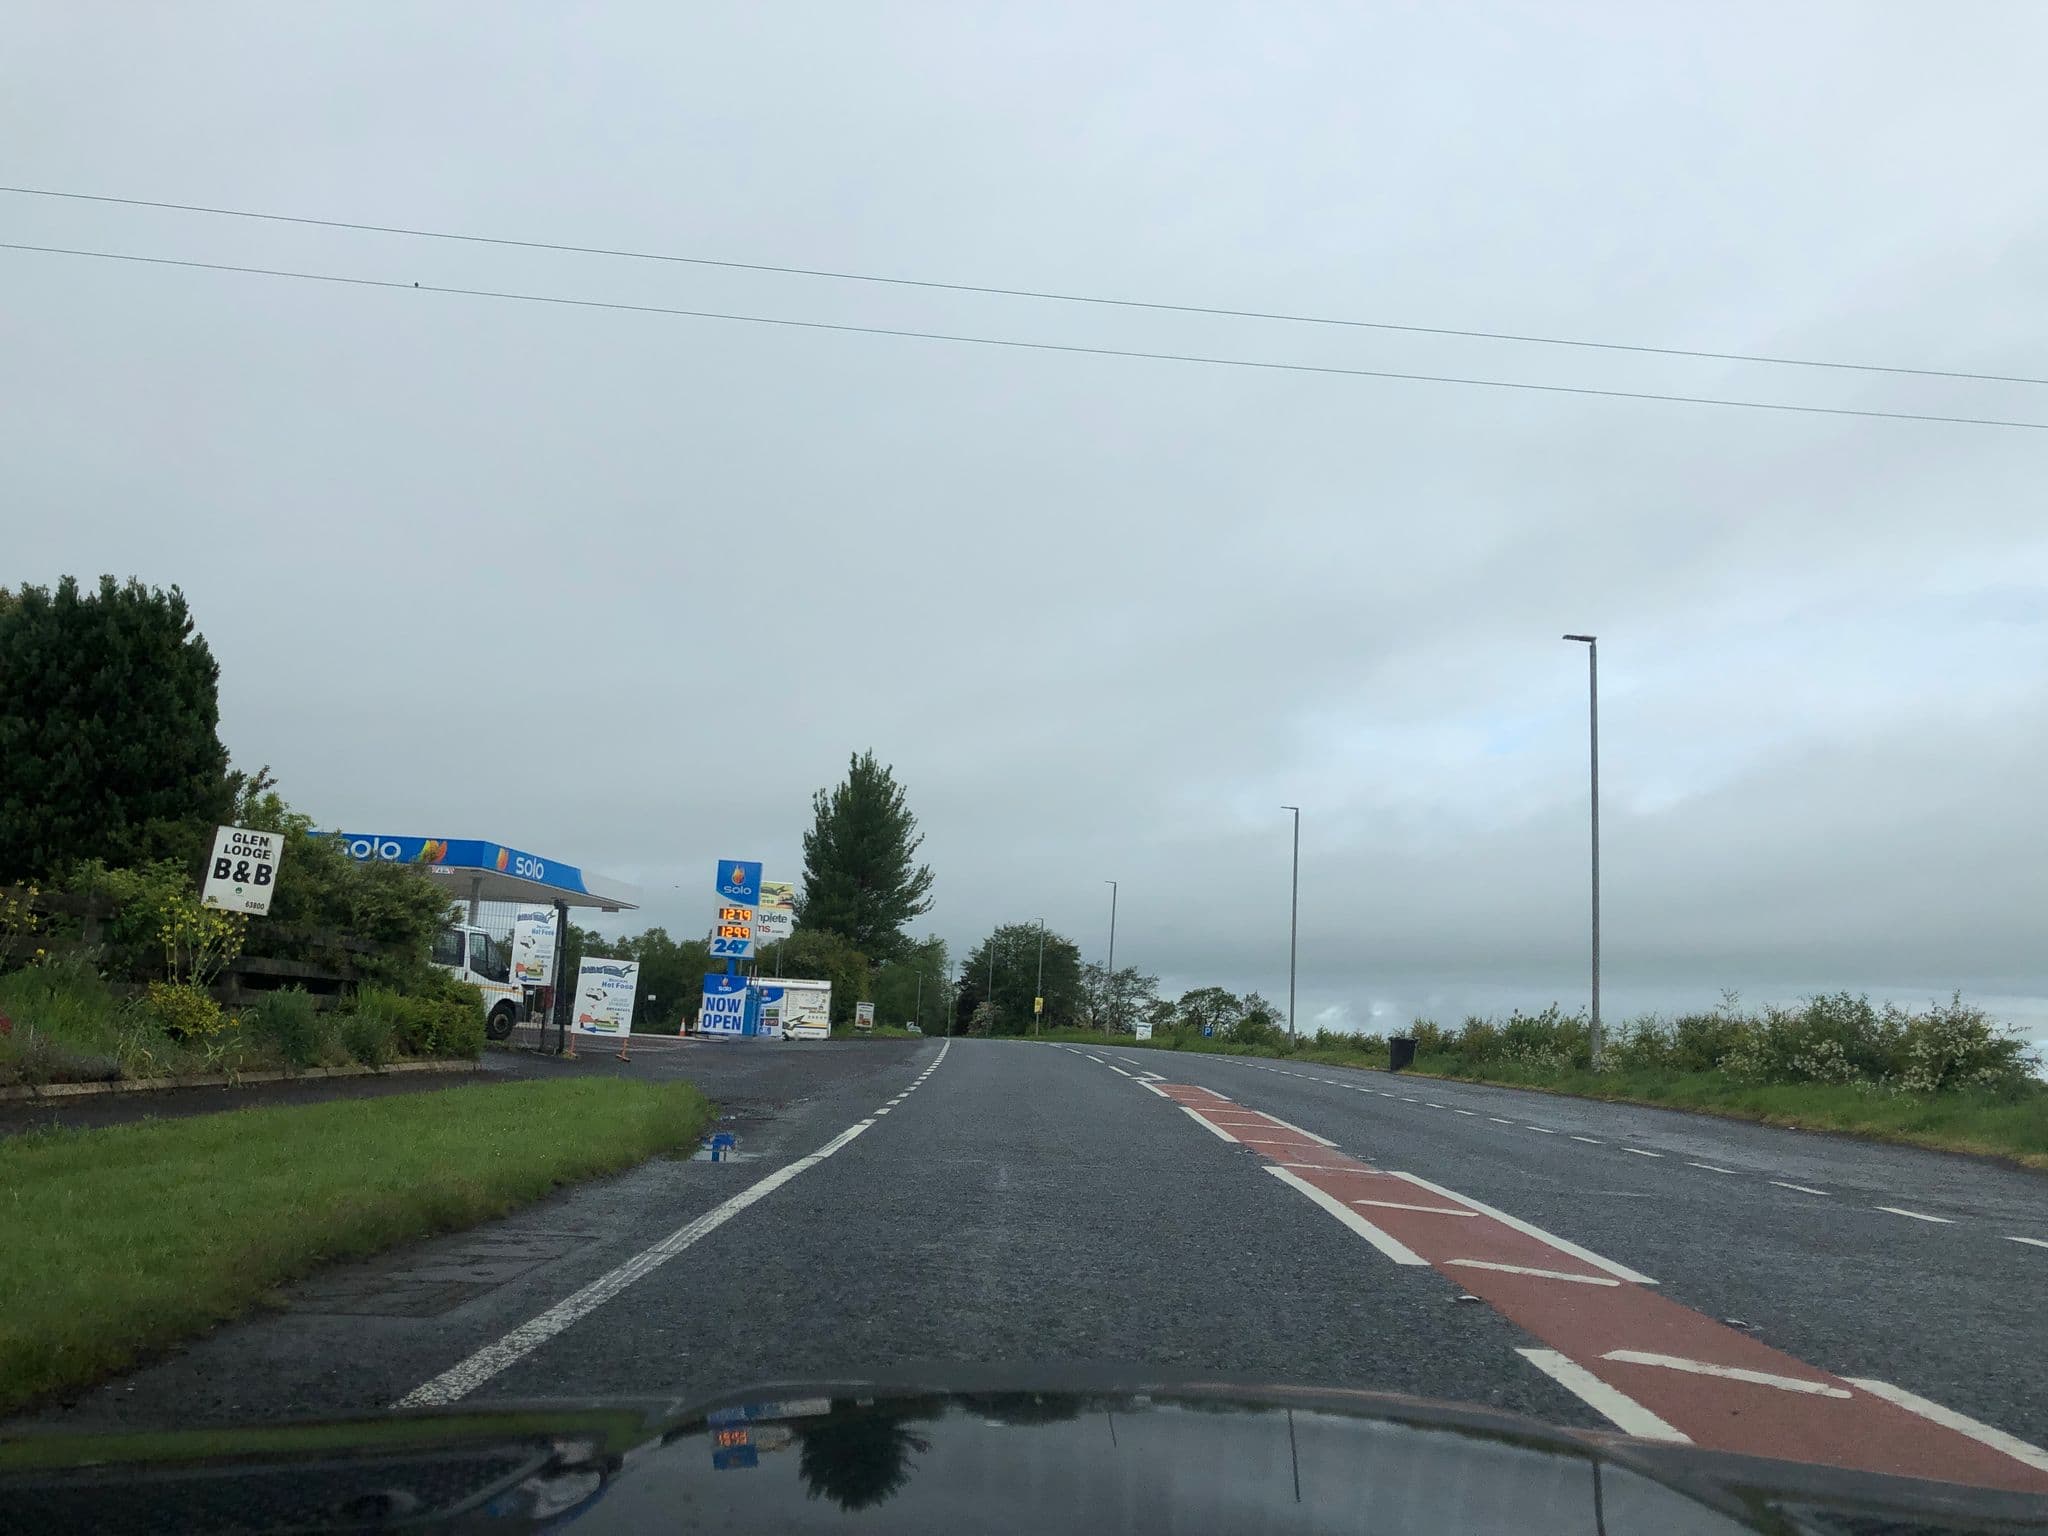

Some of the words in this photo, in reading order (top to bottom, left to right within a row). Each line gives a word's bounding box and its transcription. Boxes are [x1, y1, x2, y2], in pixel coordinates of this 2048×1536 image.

[232, 832, 270, 847] GLEN
[223, 844, 271, 860] LODGE
[213, 857, 272, 886] B&B
[515, 856, 544, 880] solo
[723, 885, 752, 896] solo
[705, 997, 742, 1013] NOW
[702, 1013, 742, 1031] OPEN
[1204, 1027, 1211, 1036] P
